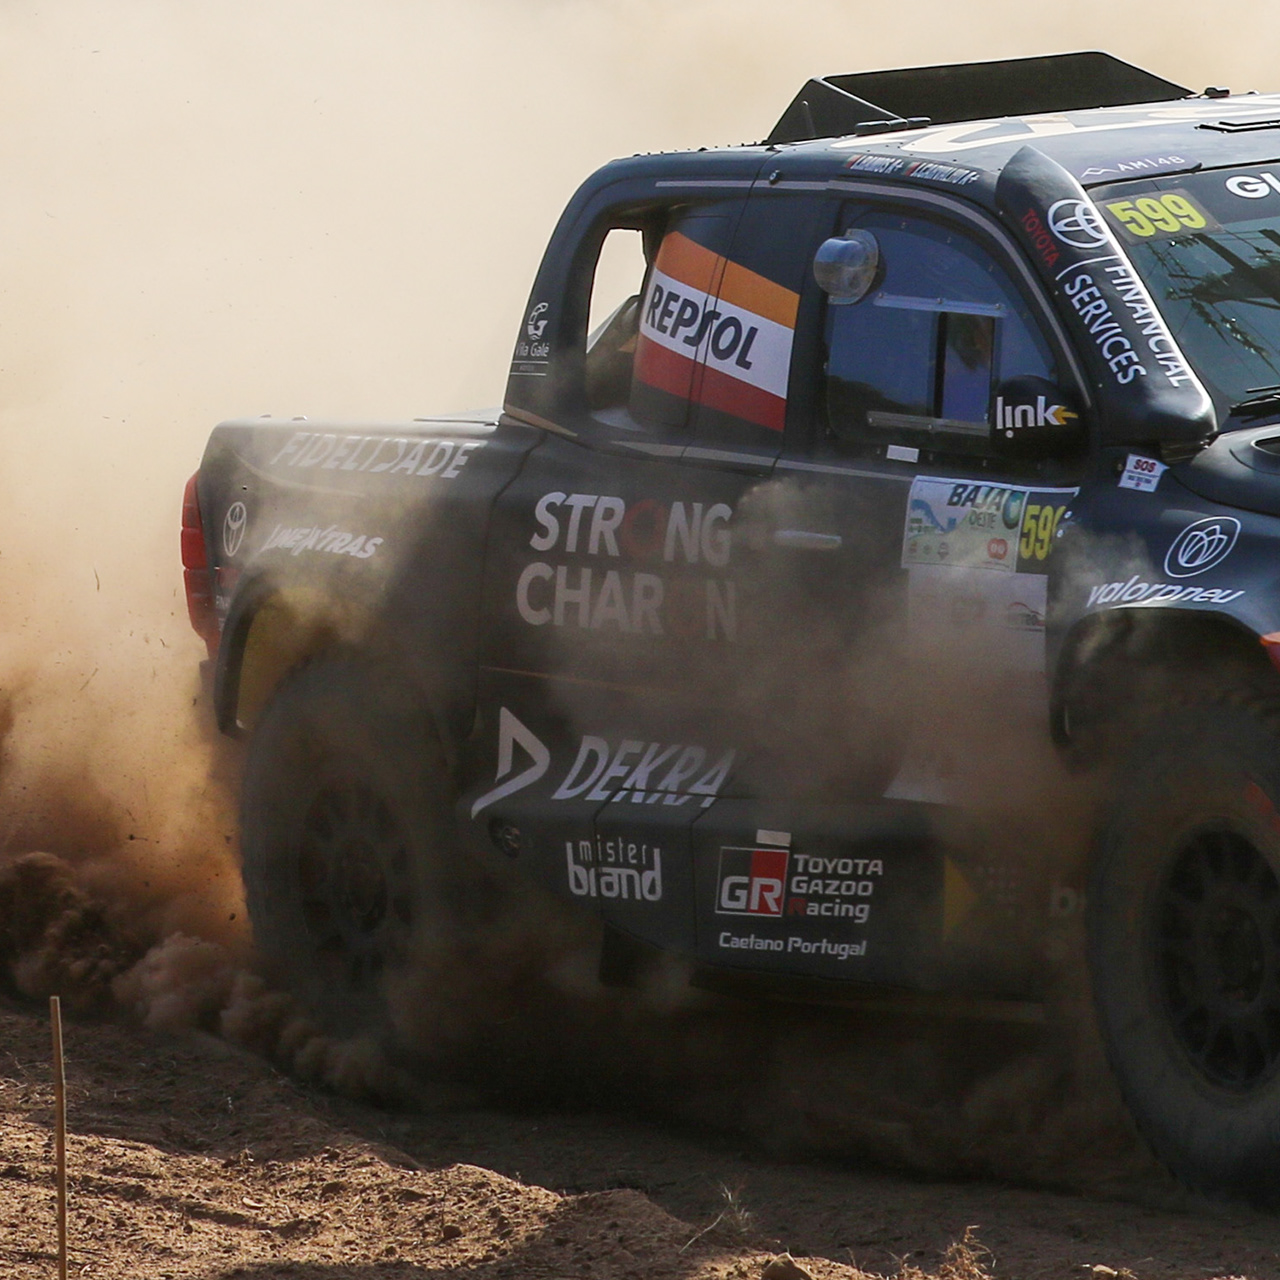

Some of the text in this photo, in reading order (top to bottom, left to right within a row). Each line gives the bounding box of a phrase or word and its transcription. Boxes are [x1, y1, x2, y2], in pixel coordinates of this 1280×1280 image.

[1106, 194, 1207, 237] 599
[1022, 208, 1061, 268] TOYOTA
[646, 284, 759, 370] REPSOL
[1064, 274, 1147, 384] SERVICES
[1104, 266, 1193, 388] FINANCIAL
[996, 396, 1063, 438] link
[270, 432, 489, 479] FIDELIDADE
[1133, 458, 1157, 473] SOS
[947, 483, 1005, 512] BAJA
[529, 491, 733, 568] STRONG
[516, 562, 737, 642] CHARN
[1086, 575, 1246, 608] valorpneu
[551, 735, 736, 808] DEKRA
[579, 835, 647, 864] mister
[793, 854, 883, 876] TOYOTA
[566, 842, 662, 901] brand
[791, 876, 873, 896] GAZOO
[721, 875, 782, 913] GR
[788, 897, 870, 924] Racing
[719, 932, 867, 960] Caetano Portugal
